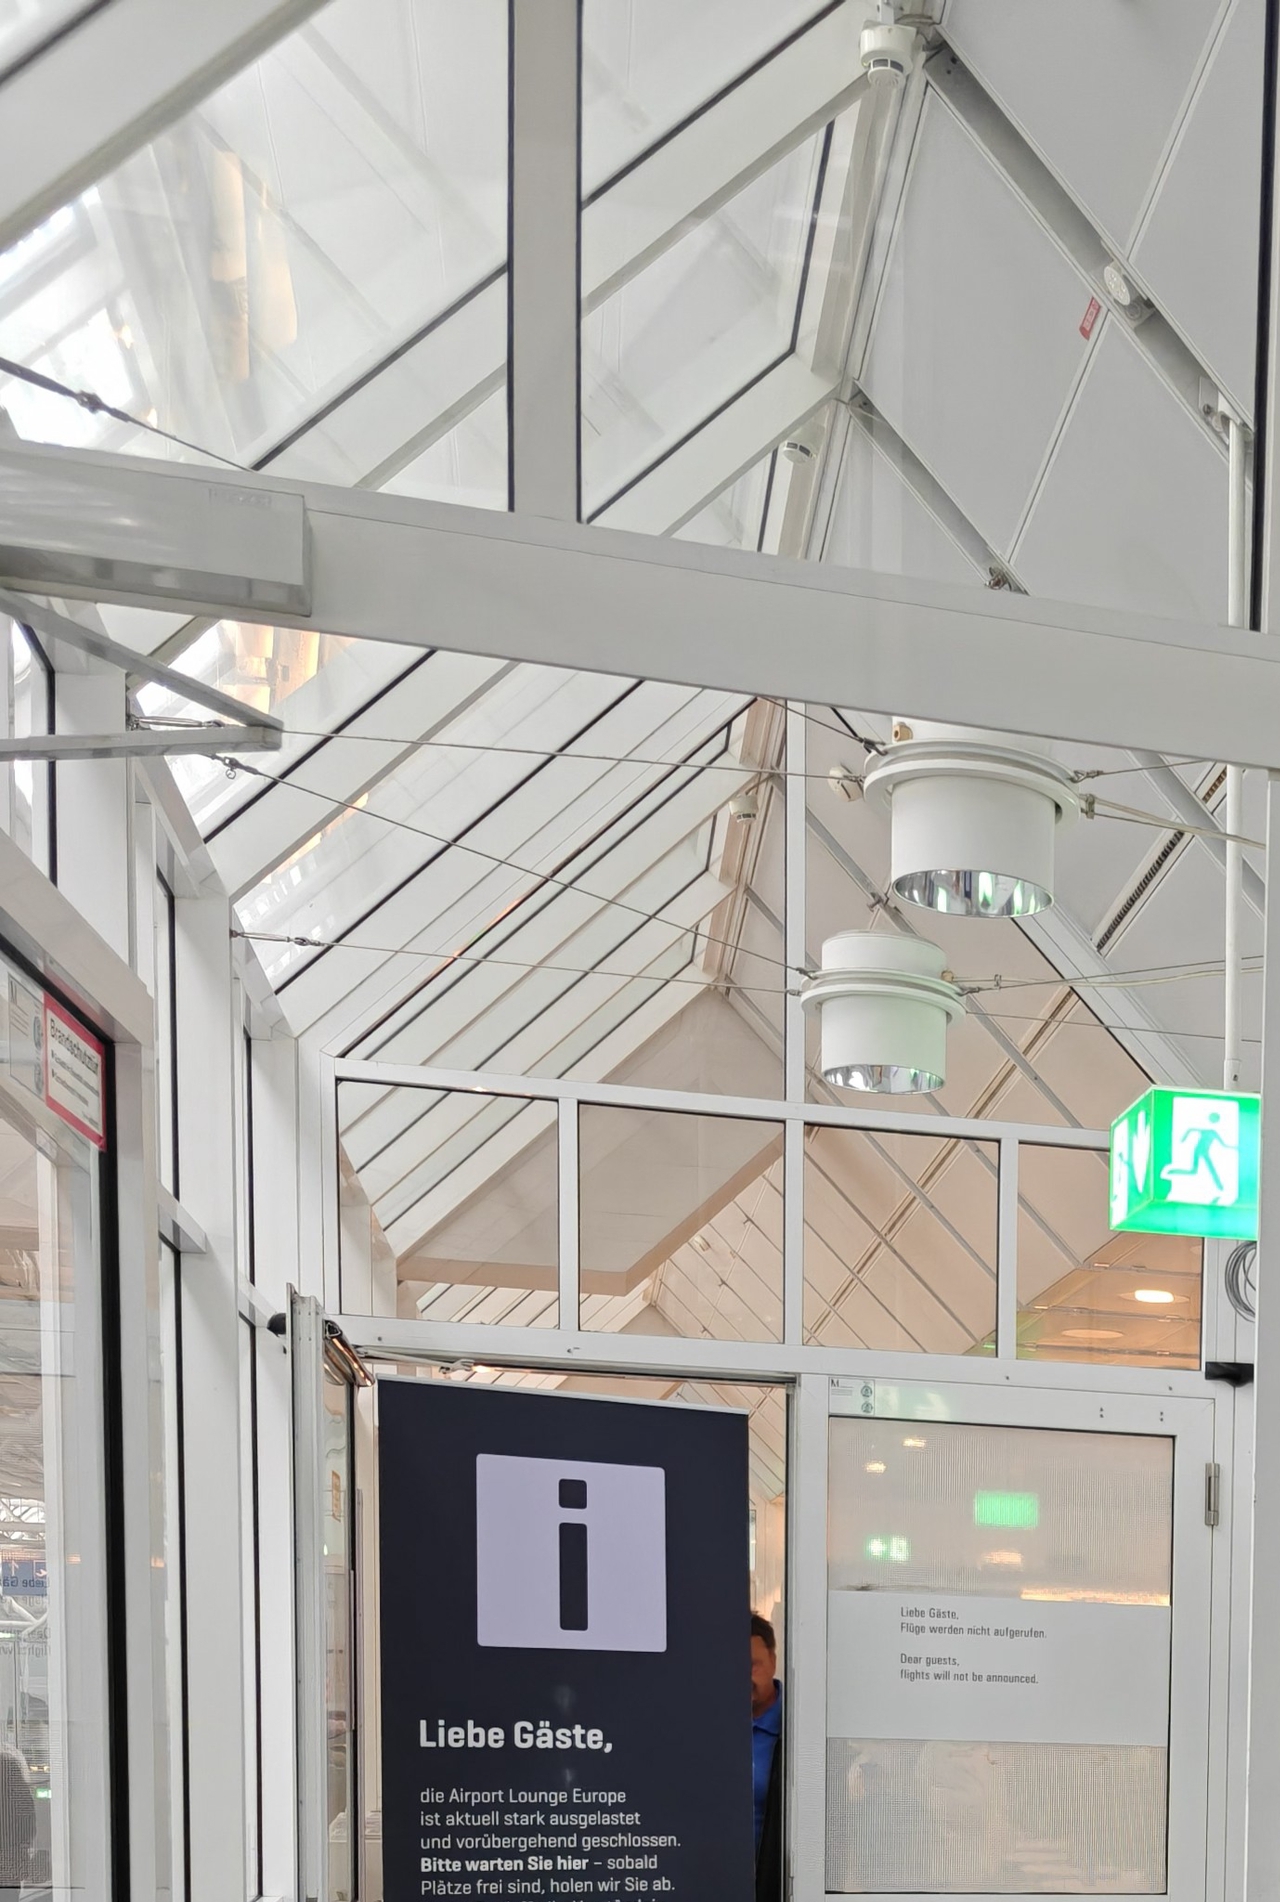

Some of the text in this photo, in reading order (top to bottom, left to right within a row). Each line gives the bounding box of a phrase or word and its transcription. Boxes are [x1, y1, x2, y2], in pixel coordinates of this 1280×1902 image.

[901, 1607, 958, 1619] Liebe Gäste,
[901, 1622, 1046, 1639] Flüge werden nicht aufgerufen.
[901, 1653, 959, 1667] Dear guests,
[901, 1669, 1038, 1683] flights will not be announced.
[420, 1720, 612, 1753] Liebe Gäste,
[421, 1788, 626, 1806] die Airport Lounge Europe
[421, 1811, 640, 1829] ist aktuell stark ausgelastet
[421, 1833, 680, 1852] und vorübergehend geschlossen.
[421, 1857, 461, 1872] Bitte
[465, 1858, 523, 1871] warten
[528, 1856, 553, 1870] Sie
[557, 1856, 589, 1870] hier
[608, 1855, 657, 1869] sobald
[422, 1877, 675, 1895] Plätze frei sind, holen wir Sie ab.
